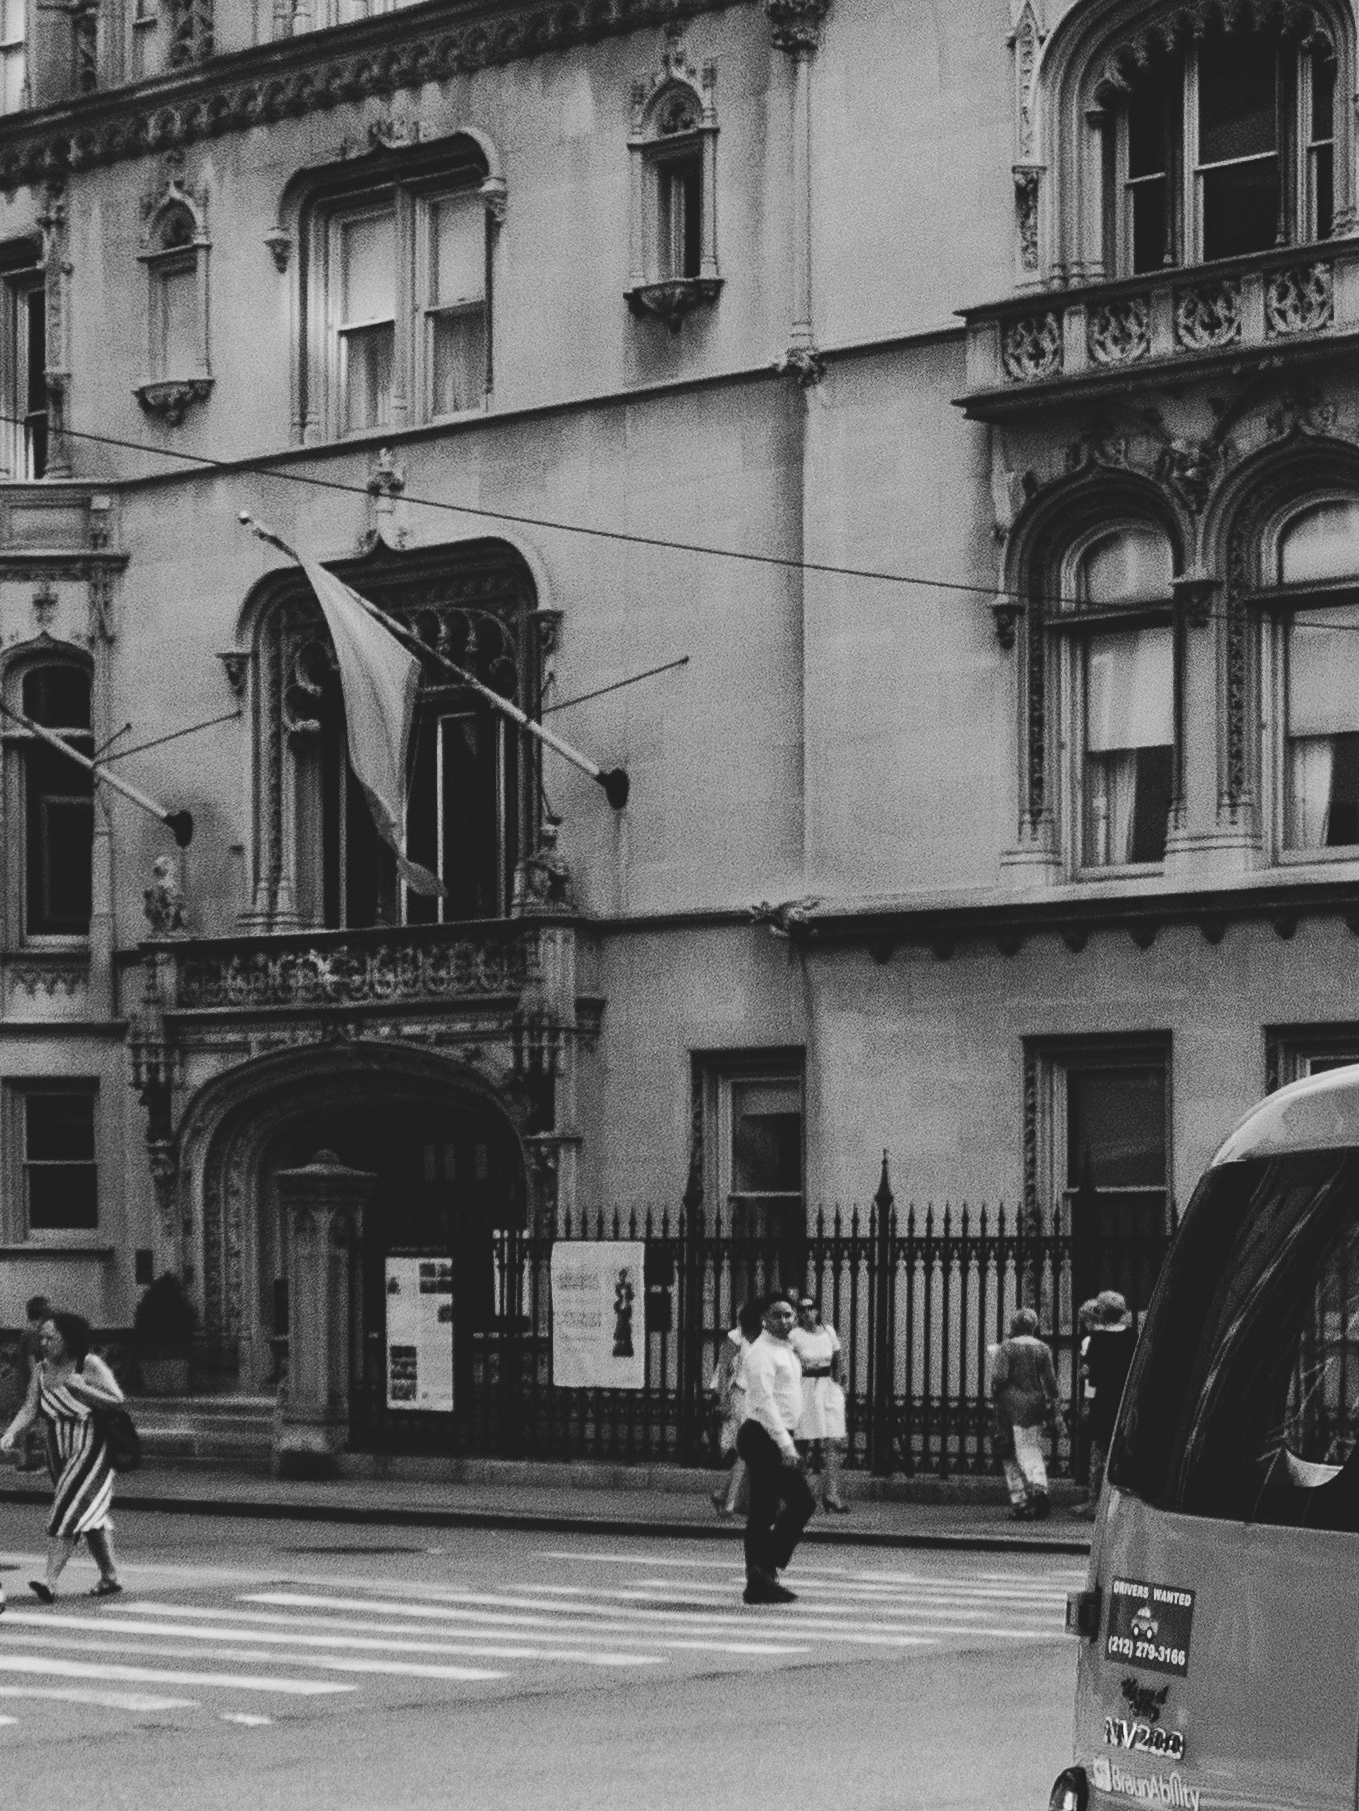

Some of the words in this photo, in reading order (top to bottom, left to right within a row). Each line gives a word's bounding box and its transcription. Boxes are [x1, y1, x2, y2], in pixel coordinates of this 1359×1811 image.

[1113, 1581, 1149, 1599] DRIVERS
[1153, 1588, 1192, 1607] WANTED
[1108, 1635, 1134, 1659] (212)
[1104, 1716, 1184, 1760] NV200
[1111, 1764, 1200, 1811] BraunAbility
